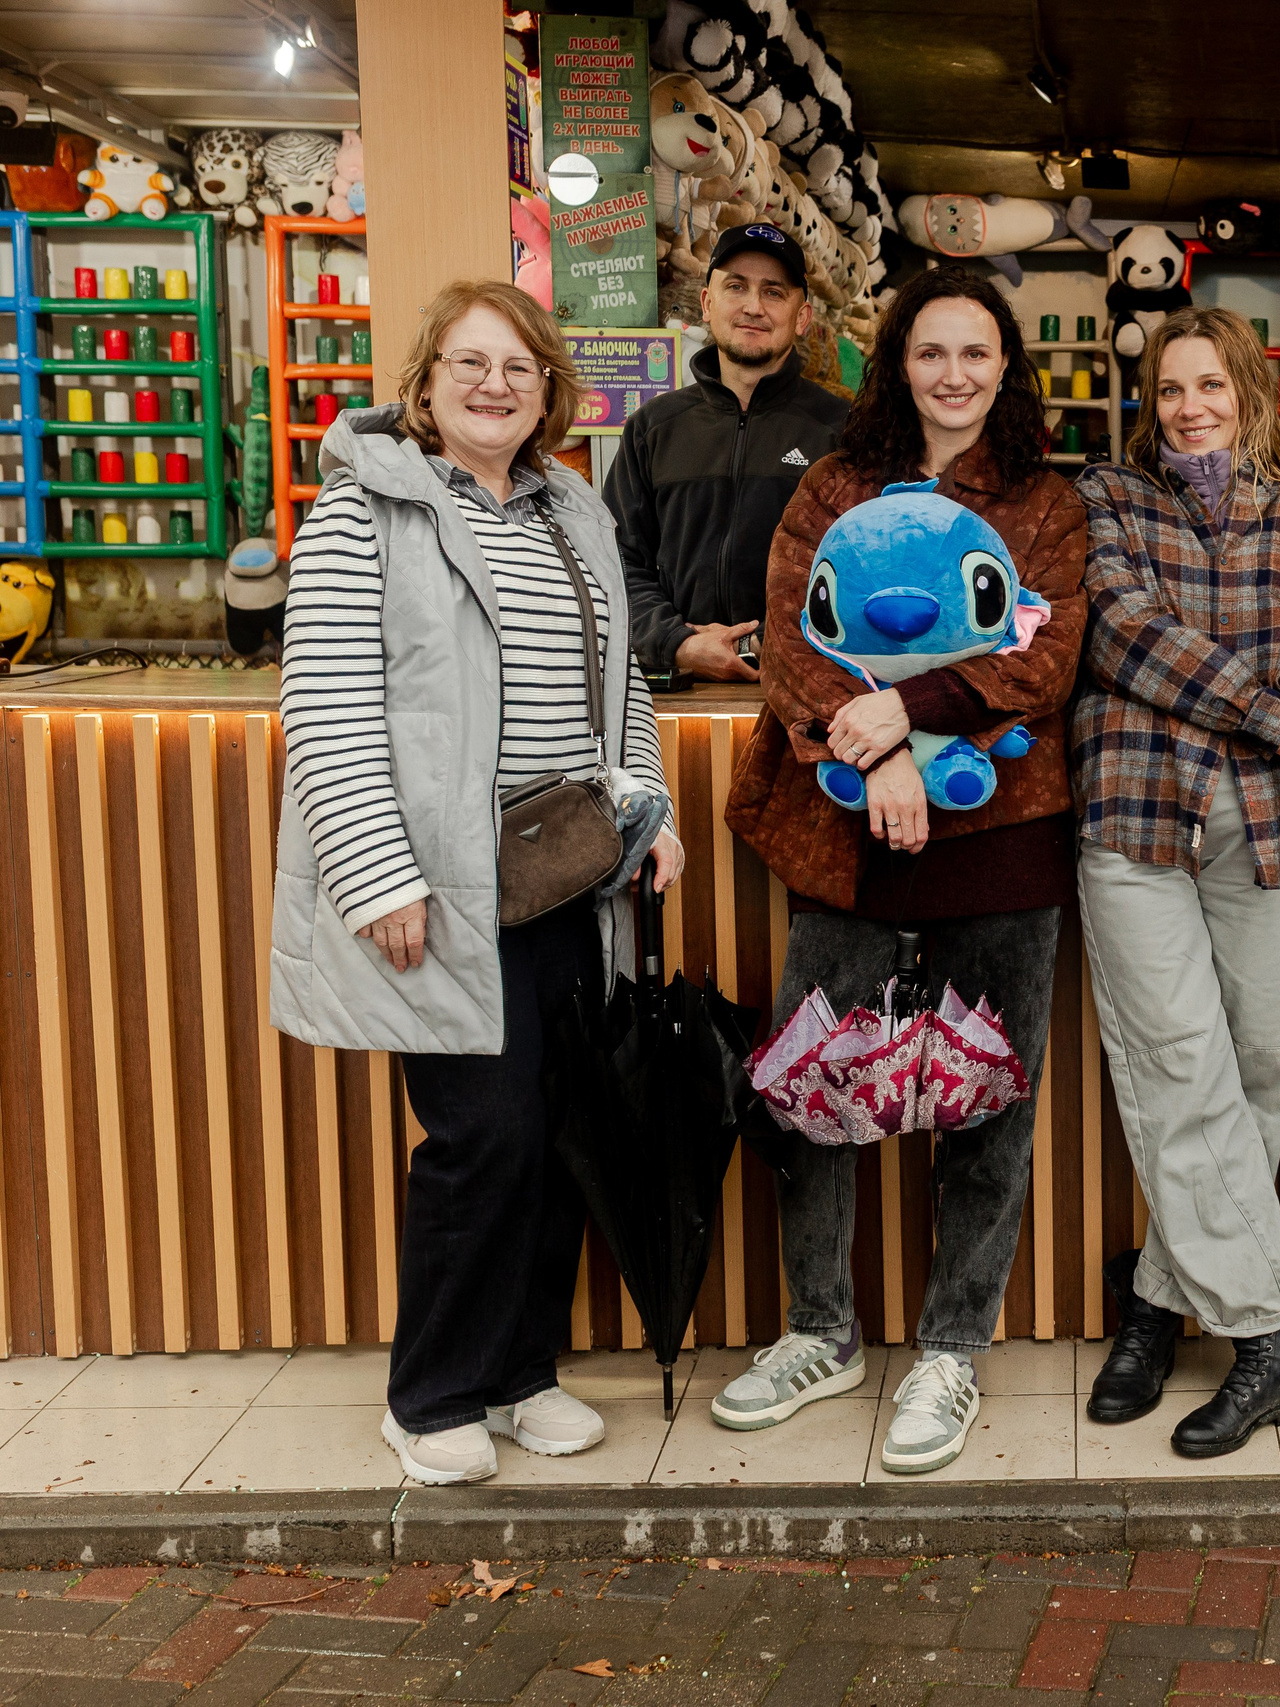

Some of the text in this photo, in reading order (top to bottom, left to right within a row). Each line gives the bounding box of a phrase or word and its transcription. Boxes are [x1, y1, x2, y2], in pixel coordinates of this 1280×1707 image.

[569, 36, 619, 51] ЛЮБОЙ
[555, 54, 635, 69] ИГРАЮЩИЙ
[570, 72, 620, 85] МОЖЕТ
[559, 88, 632, 103] ВЫИГРАТЬ
[563, 106, 629, 120] НЕ БОЛЕЕ
[553, 123, 640, 137] 2-Х ИГРУШЕК
[571, 140, 624, 154] В ДЕНЬ.
[551, 190, 649, 230] УВАЖАЕМЫЕ
[566, 212, 647, 247] МУЖЧИНЫ
[570, 255, 645, 278] СТРЕЛЯЮТ
[598, 275, 625, 291] БЕЗ
[591, 291, 637, 310] УПОРА
[580, 341, 642, 356] «БАНОЧКИ»
[781, 456, 809, 466] adidas
